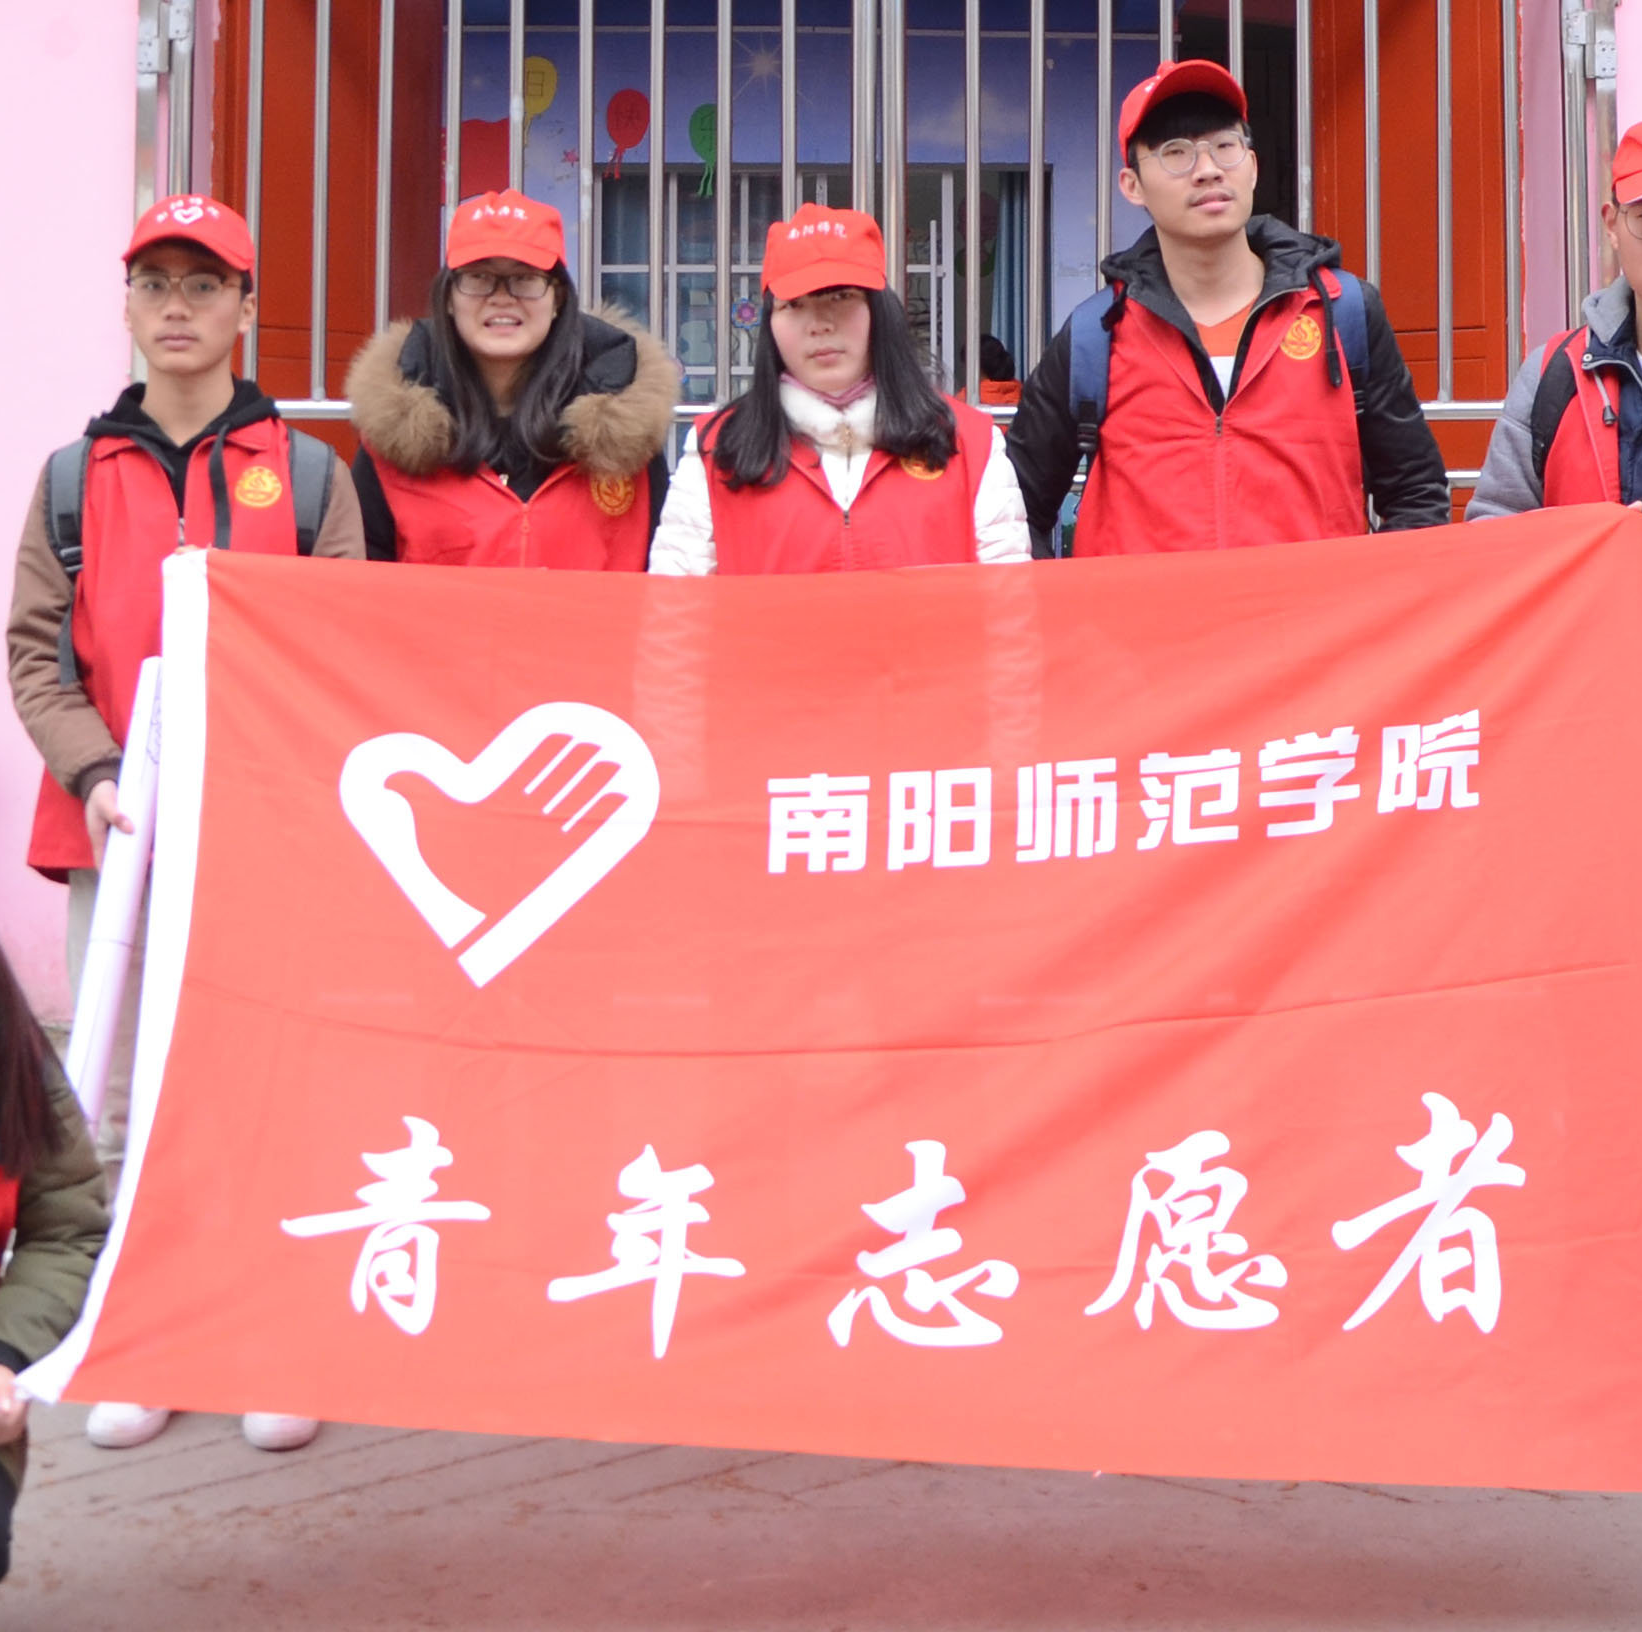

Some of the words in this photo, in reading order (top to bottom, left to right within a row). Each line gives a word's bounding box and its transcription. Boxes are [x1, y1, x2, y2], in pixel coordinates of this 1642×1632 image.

[767, 708, 1481, 874] 南阳师范学院
[280, 1091, 1526, 1359] 青年志愿者
